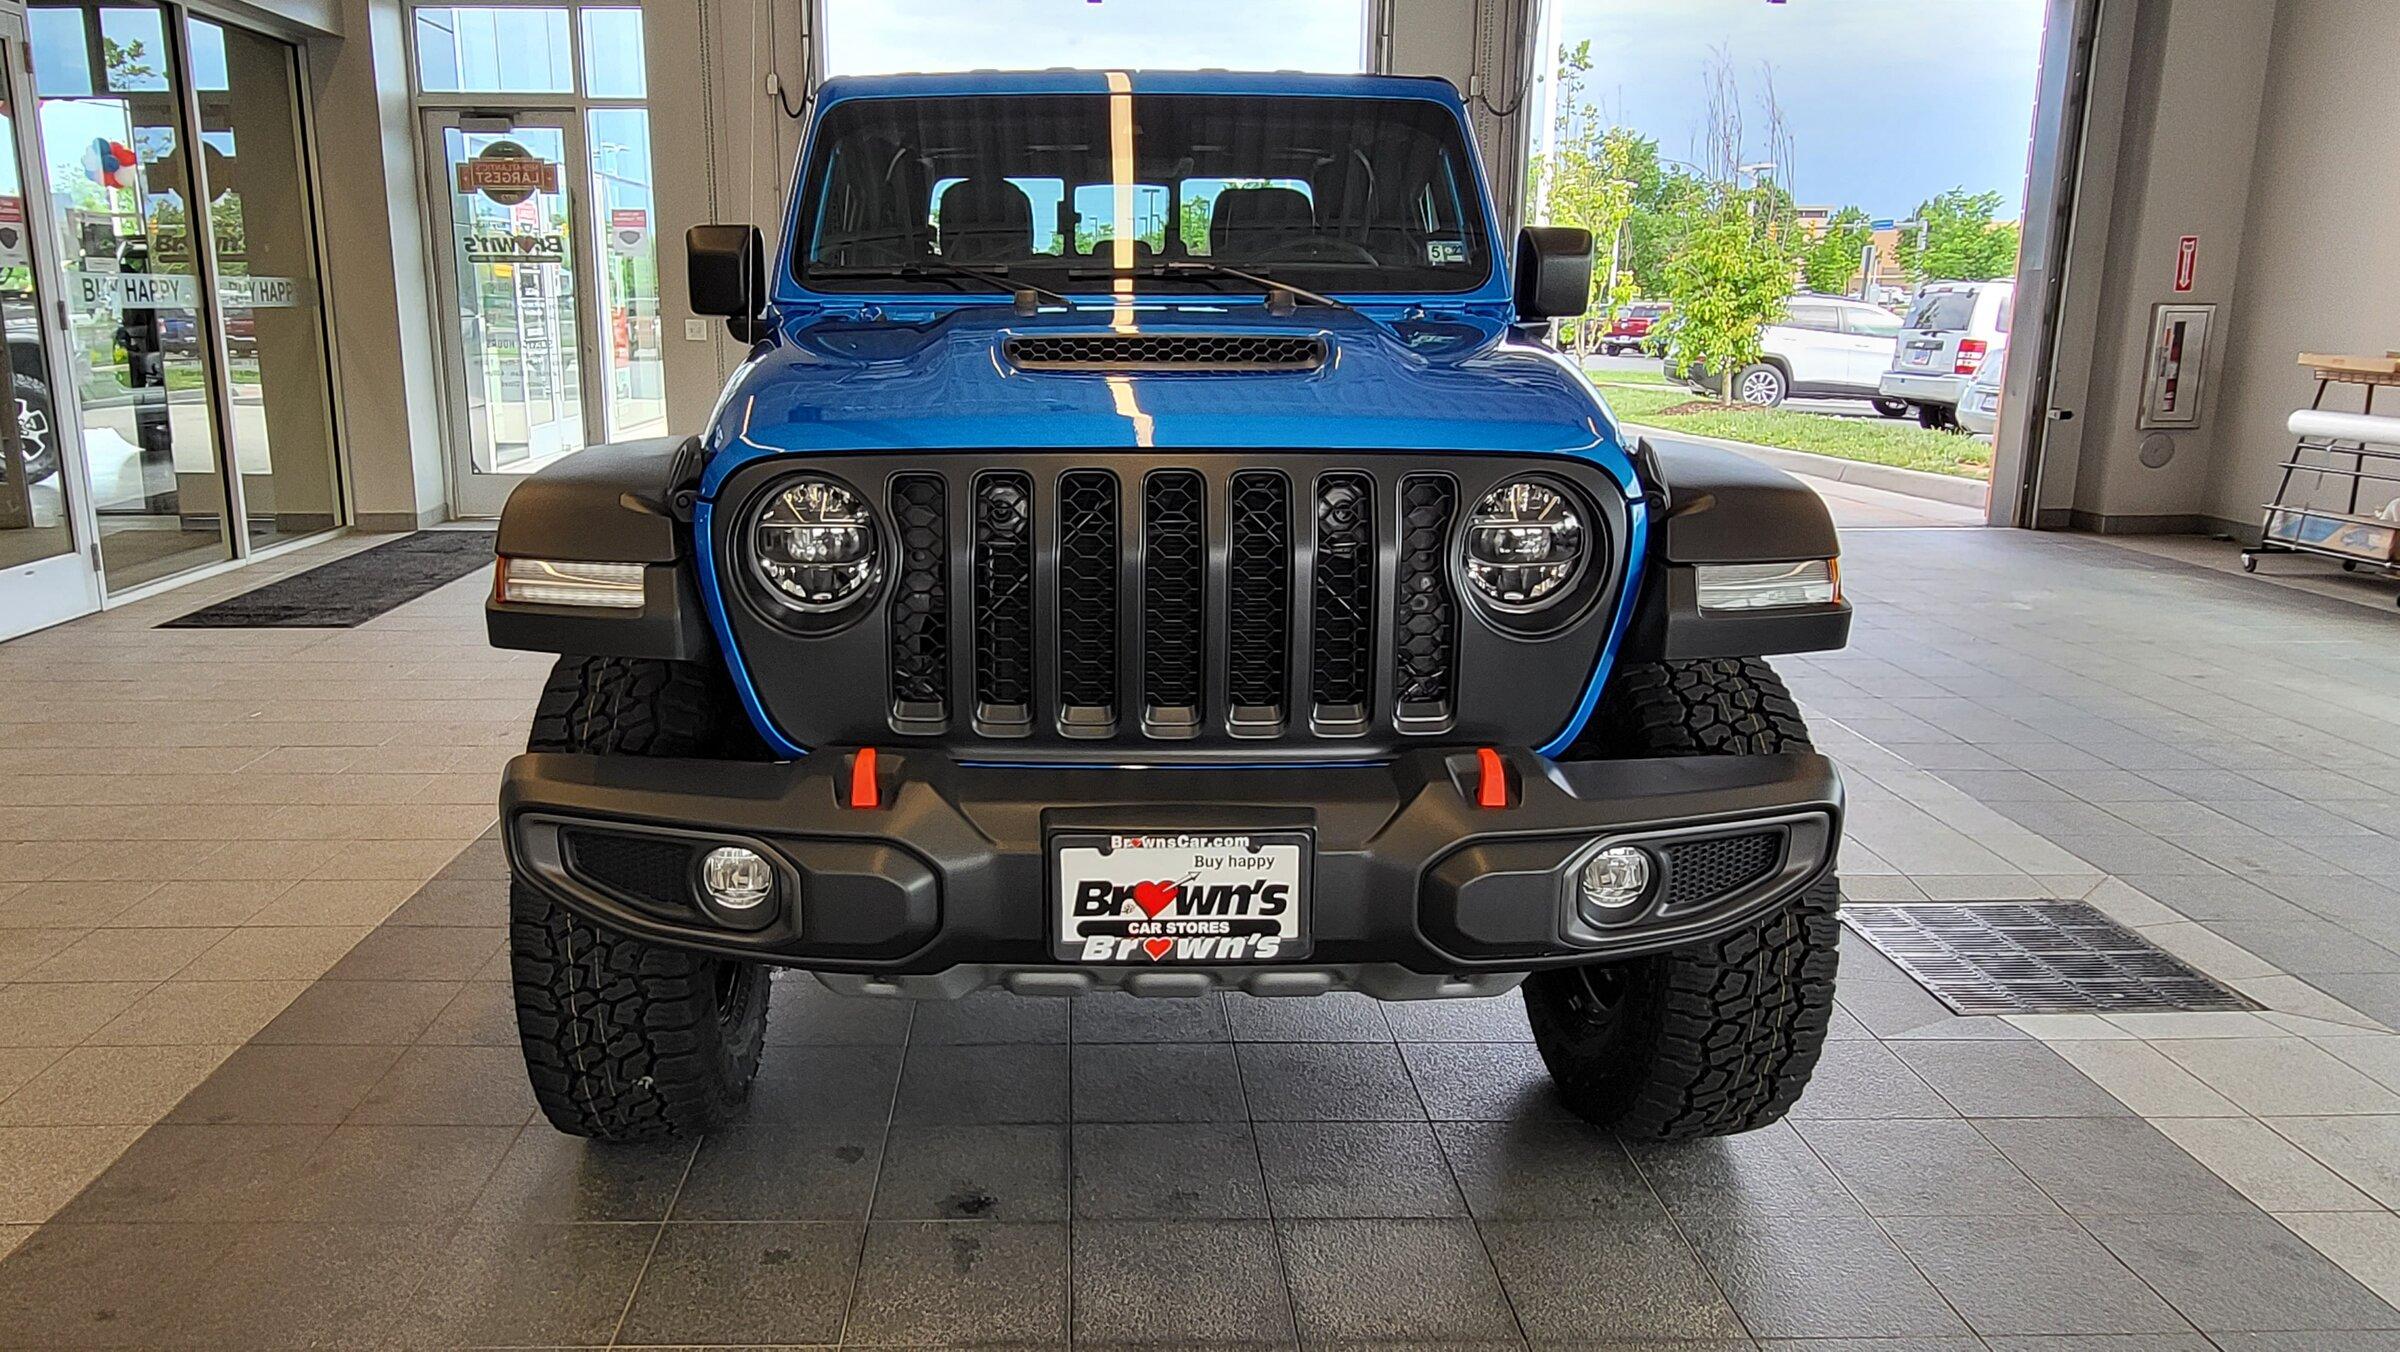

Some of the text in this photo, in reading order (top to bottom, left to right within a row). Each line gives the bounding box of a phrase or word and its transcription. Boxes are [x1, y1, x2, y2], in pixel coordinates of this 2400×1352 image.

[1431, 245, 1441, 259] 5
[125, 279, 180, 302] HAPPY
[260, 281, 294, 302] HAPP
[1194, 854, 1275, 870] Buy happy
[1127, 921, 1231, 935] CAR STORES
